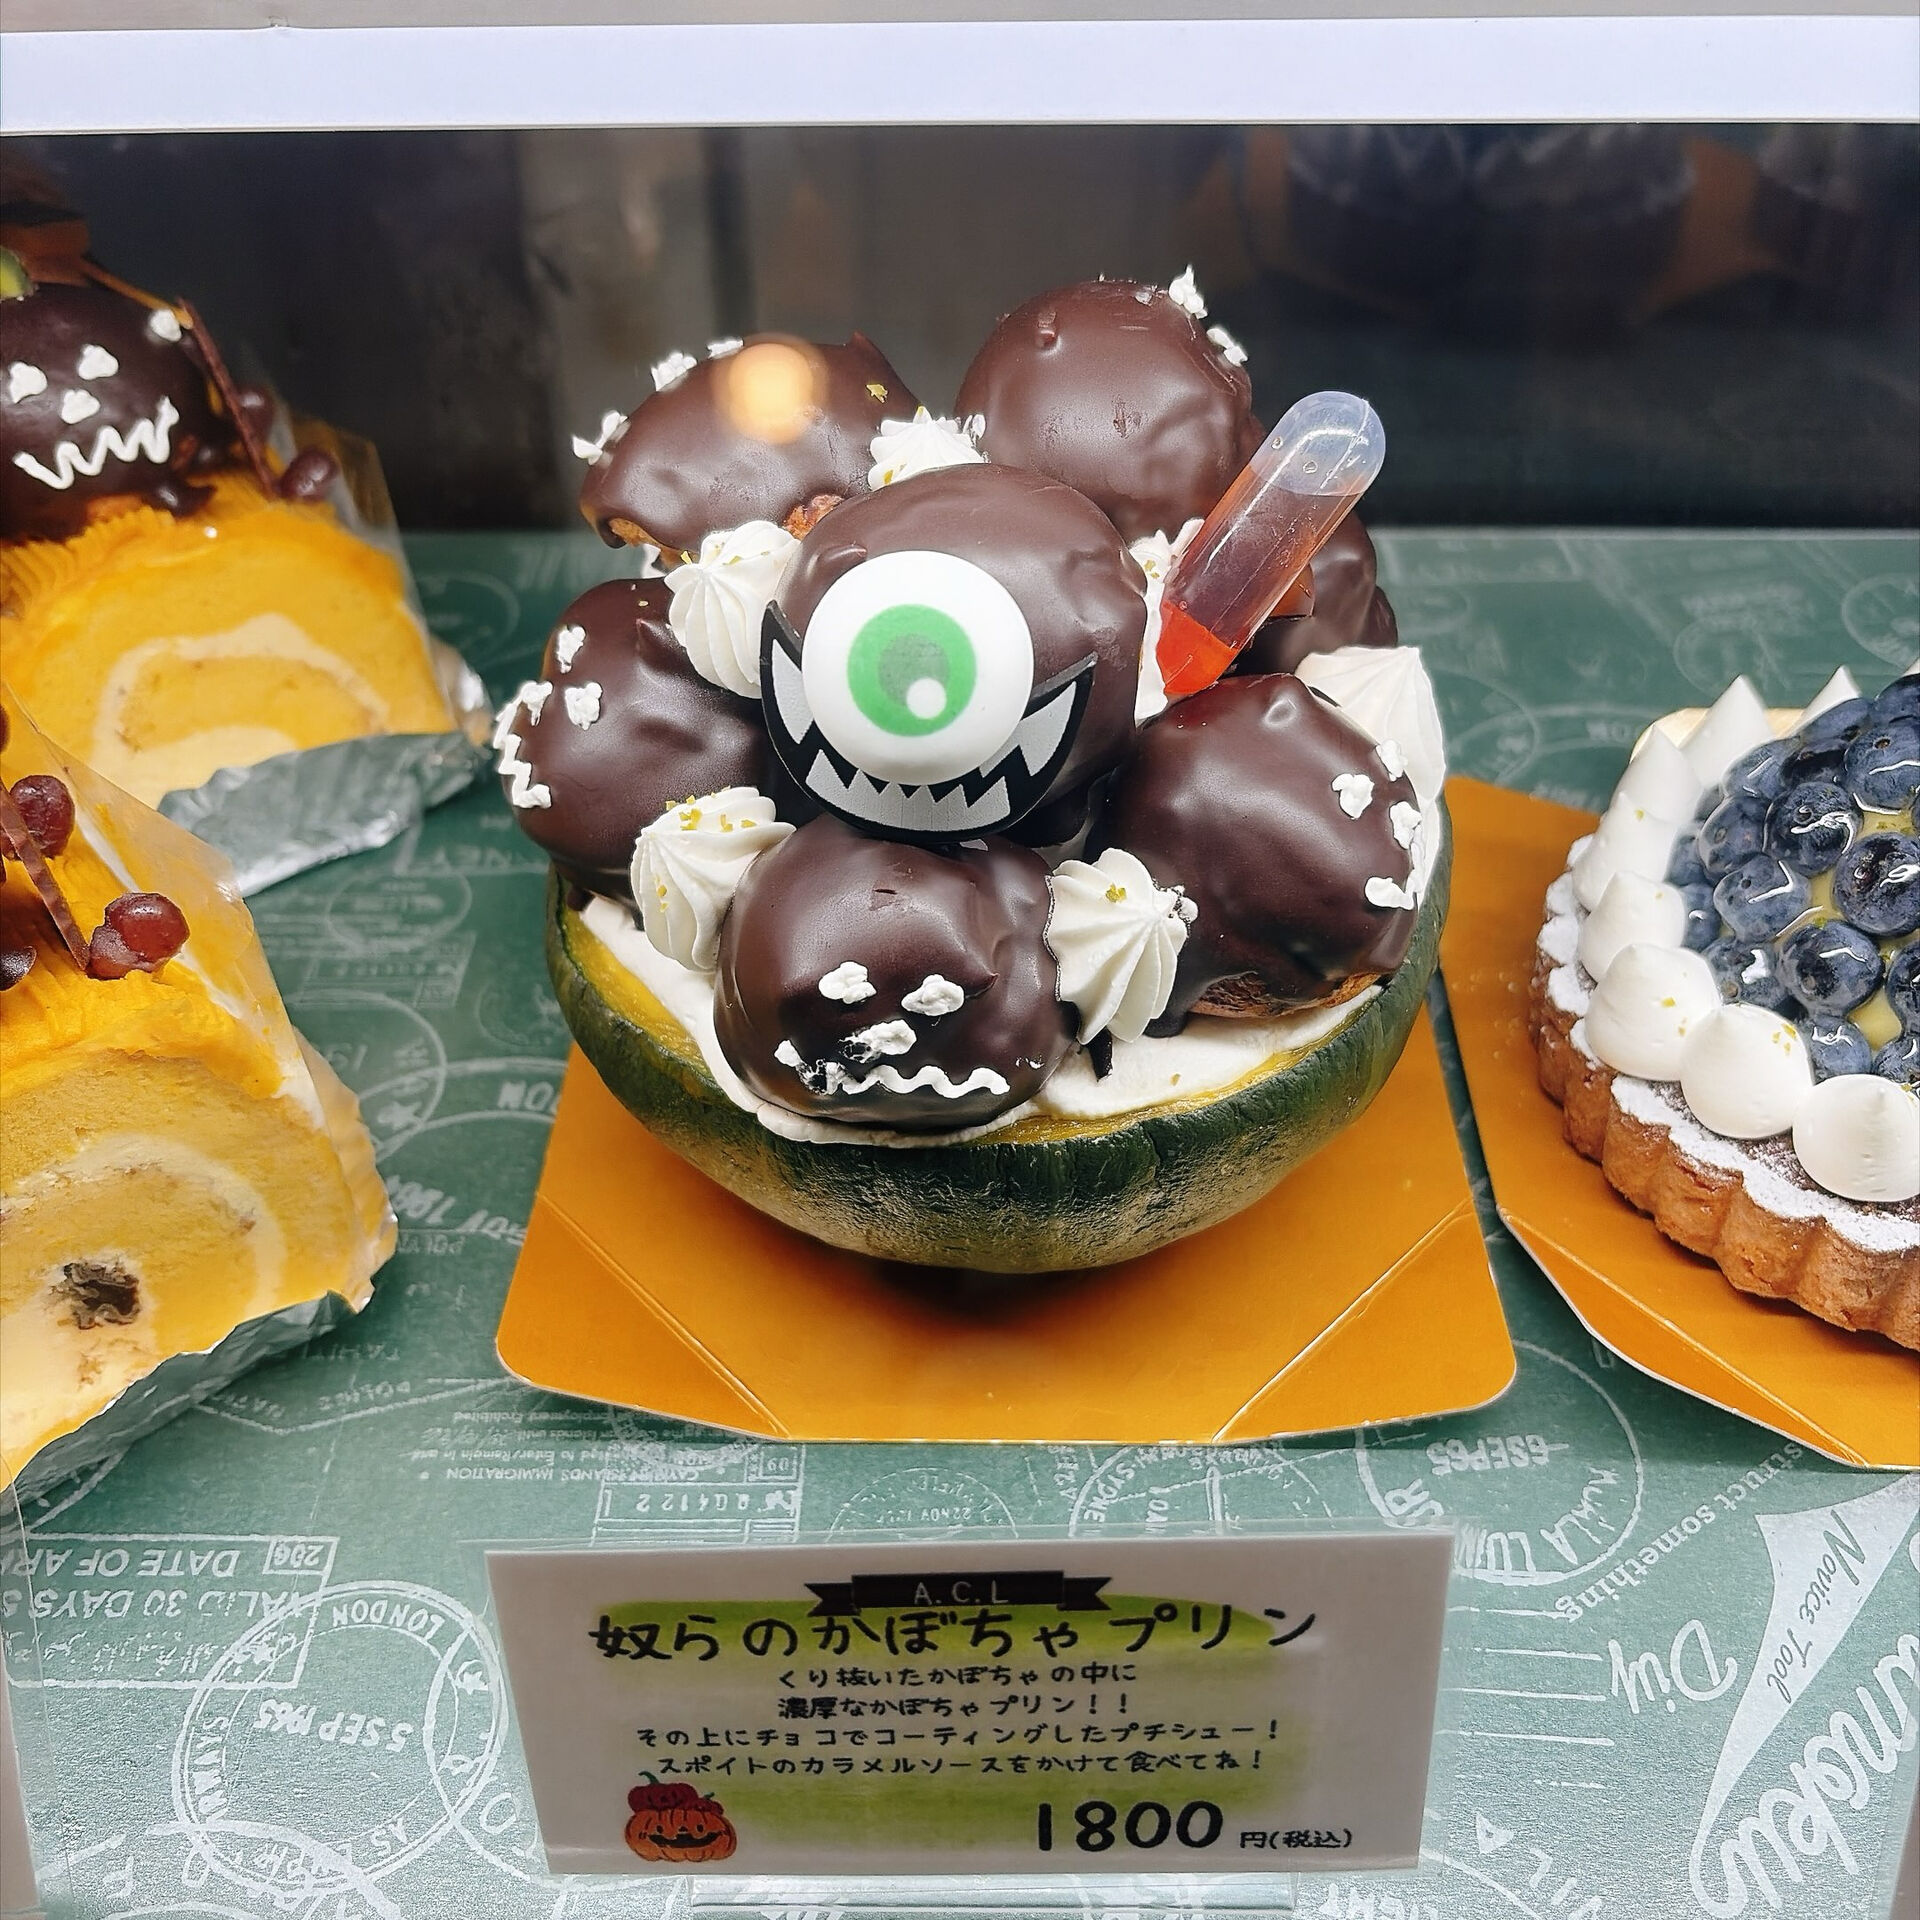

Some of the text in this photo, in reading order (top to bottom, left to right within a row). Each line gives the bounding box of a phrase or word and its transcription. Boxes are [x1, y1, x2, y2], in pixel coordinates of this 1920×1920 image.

[73, 1547, 131, 1578] OF
[135, 1547, 241, 1578] DATE
[1553, 1503, 1716, 1623] something
[27, 1587, 135, 1619] DAYS
[142, 1588, 188, 1618] 30
[331, 1597, 444, 1640] LONDON
[1765, 1509, 1866, 1705] Novice Tool
[587, 1601, 1317, 1661] 奴らのかぼちゃプリン
[778, 1661, 1137, 1688] くり抜いたかぼちゃの中に
[1606, 1618, 1738, 1715] Diy
[1037, 1800, 1224, 1852] 1800
